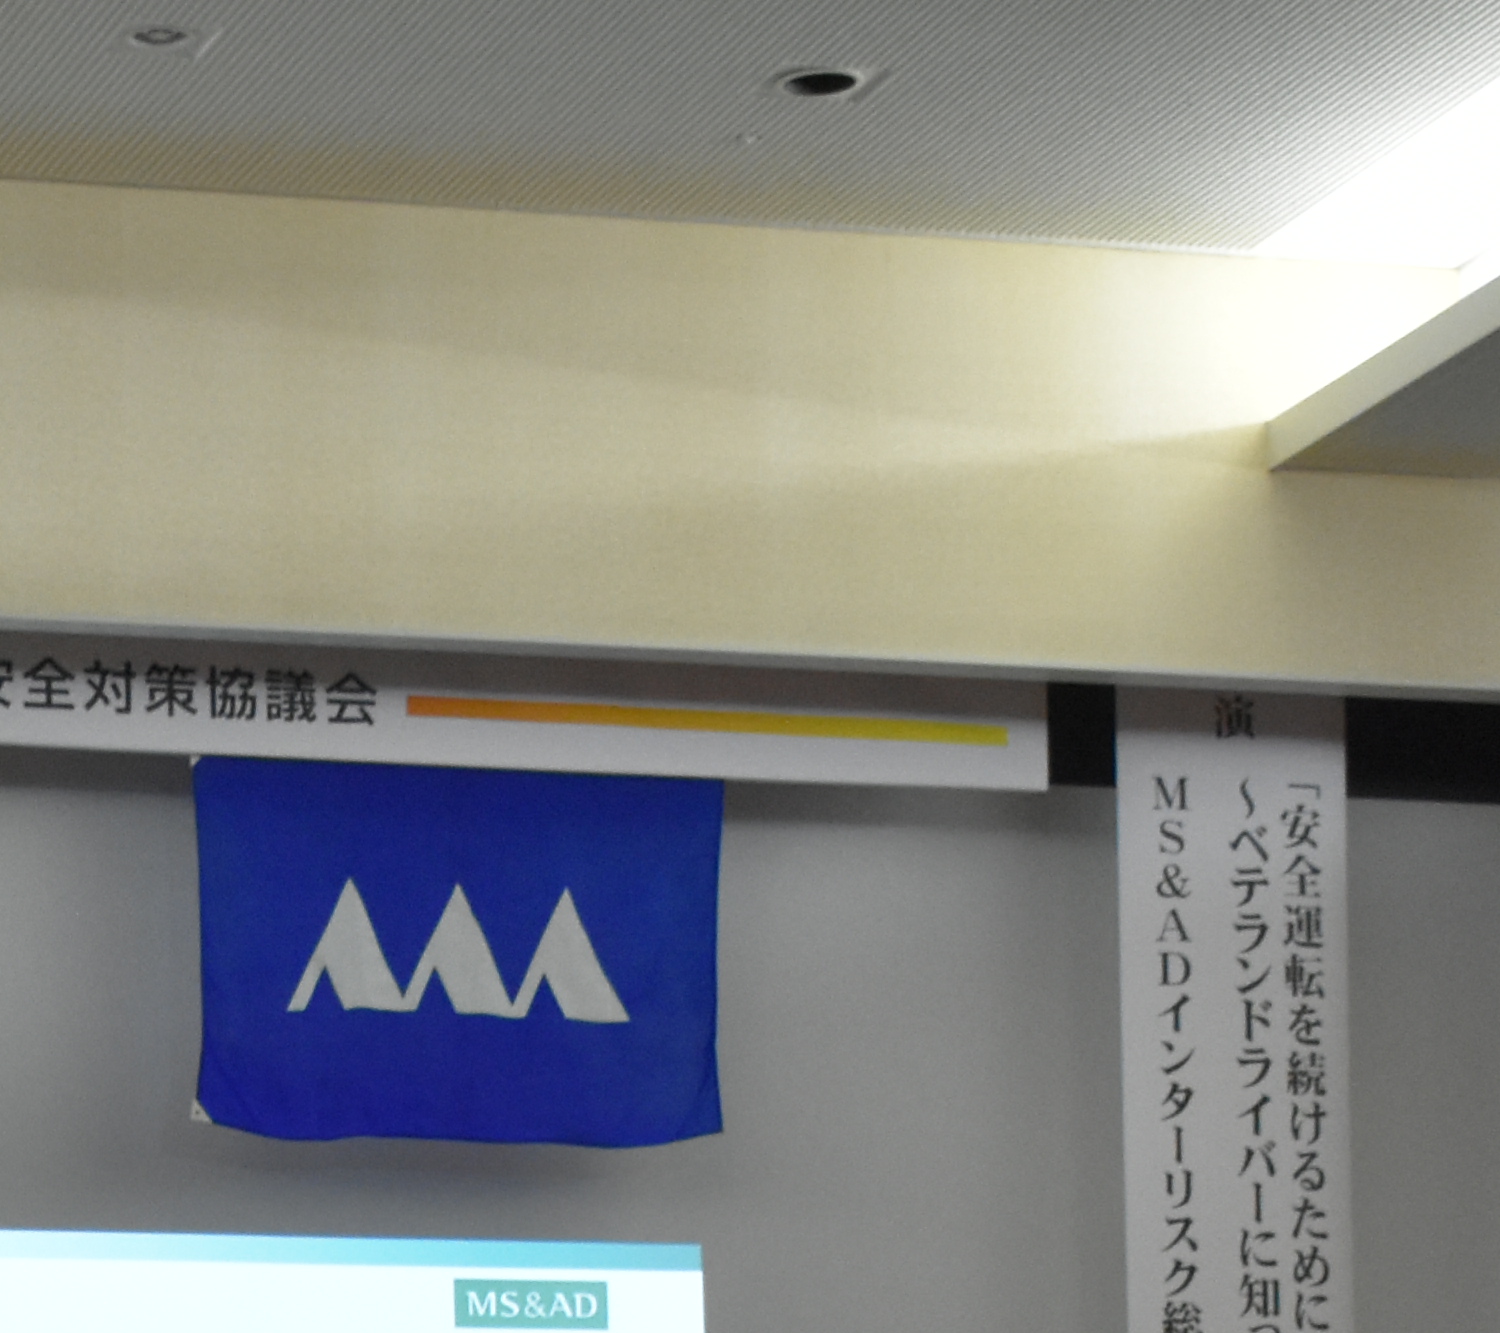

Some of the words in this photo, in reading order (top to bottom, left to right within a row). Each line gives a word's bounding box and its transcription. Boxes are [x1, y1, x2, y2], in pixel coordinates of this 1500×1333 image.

[1214, 696, 1256, 740] 演
[1279, 782, 1331, 1333] 「安全運転を続けるために
[466, 1290, 600, 1319] MS&AD
